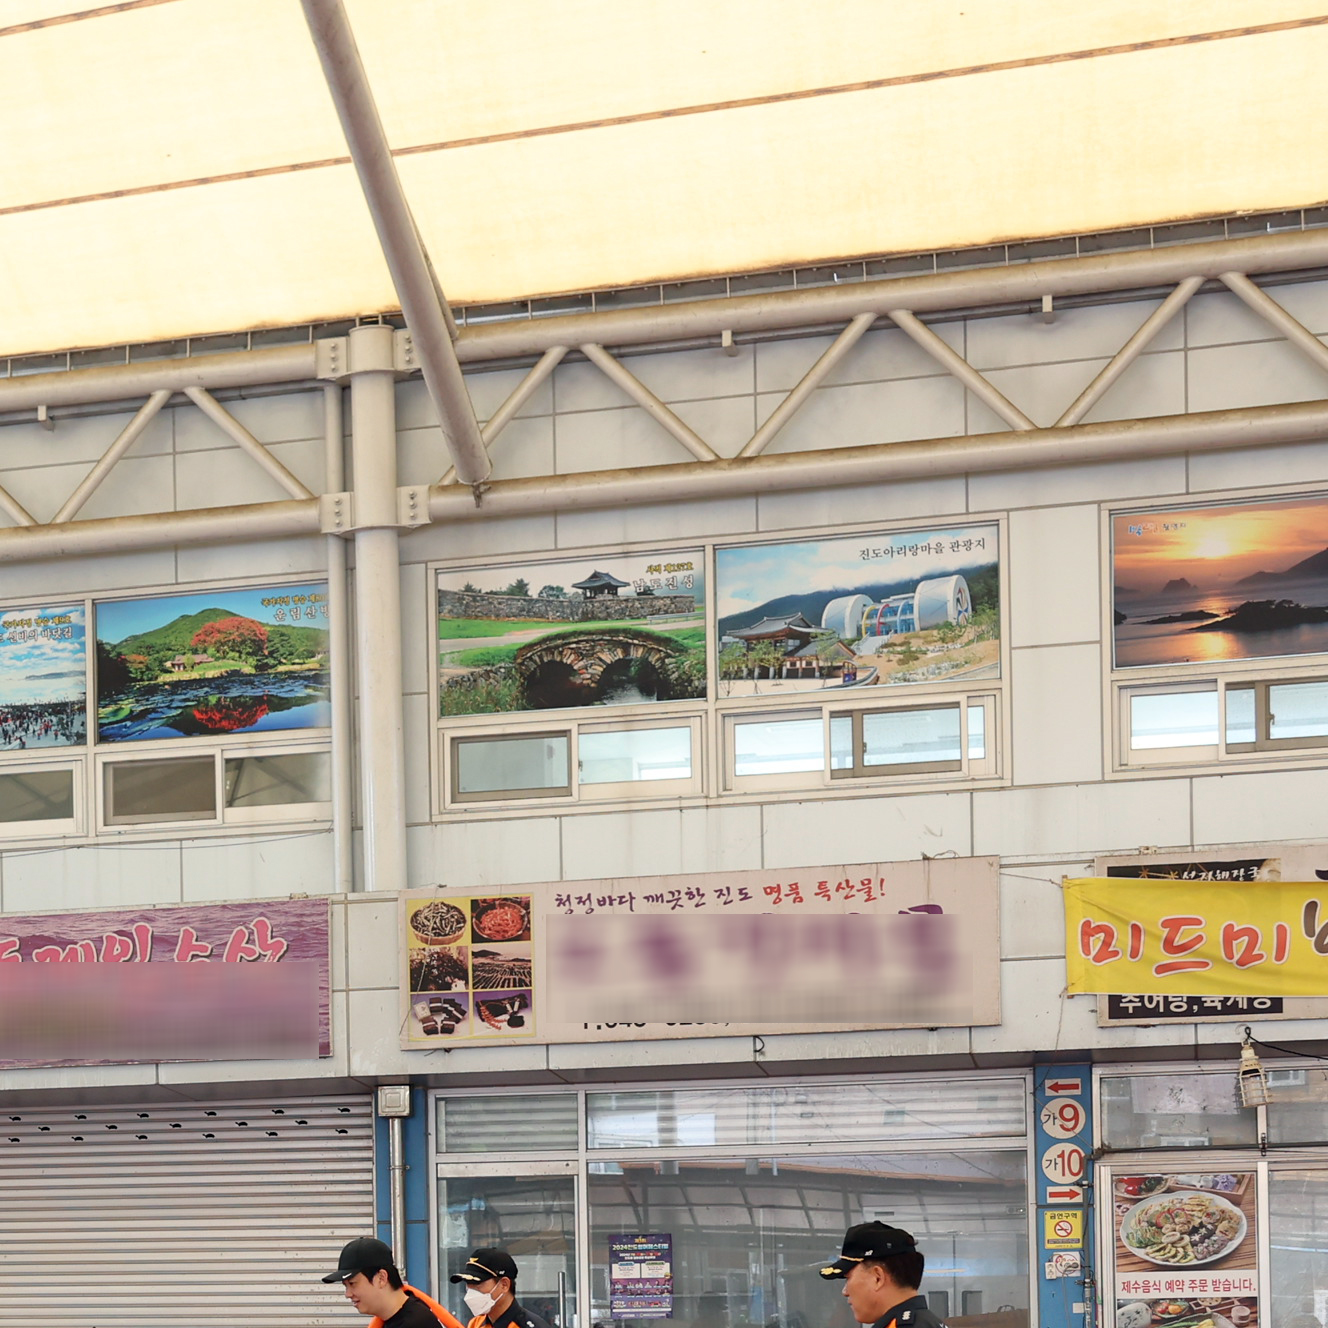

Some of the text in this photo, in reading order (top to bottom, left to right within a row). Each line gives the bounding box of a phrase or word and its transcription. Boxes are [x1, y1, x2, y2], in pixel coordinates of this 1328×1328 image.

[859, 537, 986, 561] 진도아리랑마을 관광지
[41, 626, 73, 641] 바닷길
[555, 877, 886, 915] 청정바다 깨끗한 진도 명품 특산물!
[1050, 1212, 1078, 1220] 금연구역
[1121, 1278, 1256, 1294] 제수음식 예약 주문 받습니다.
